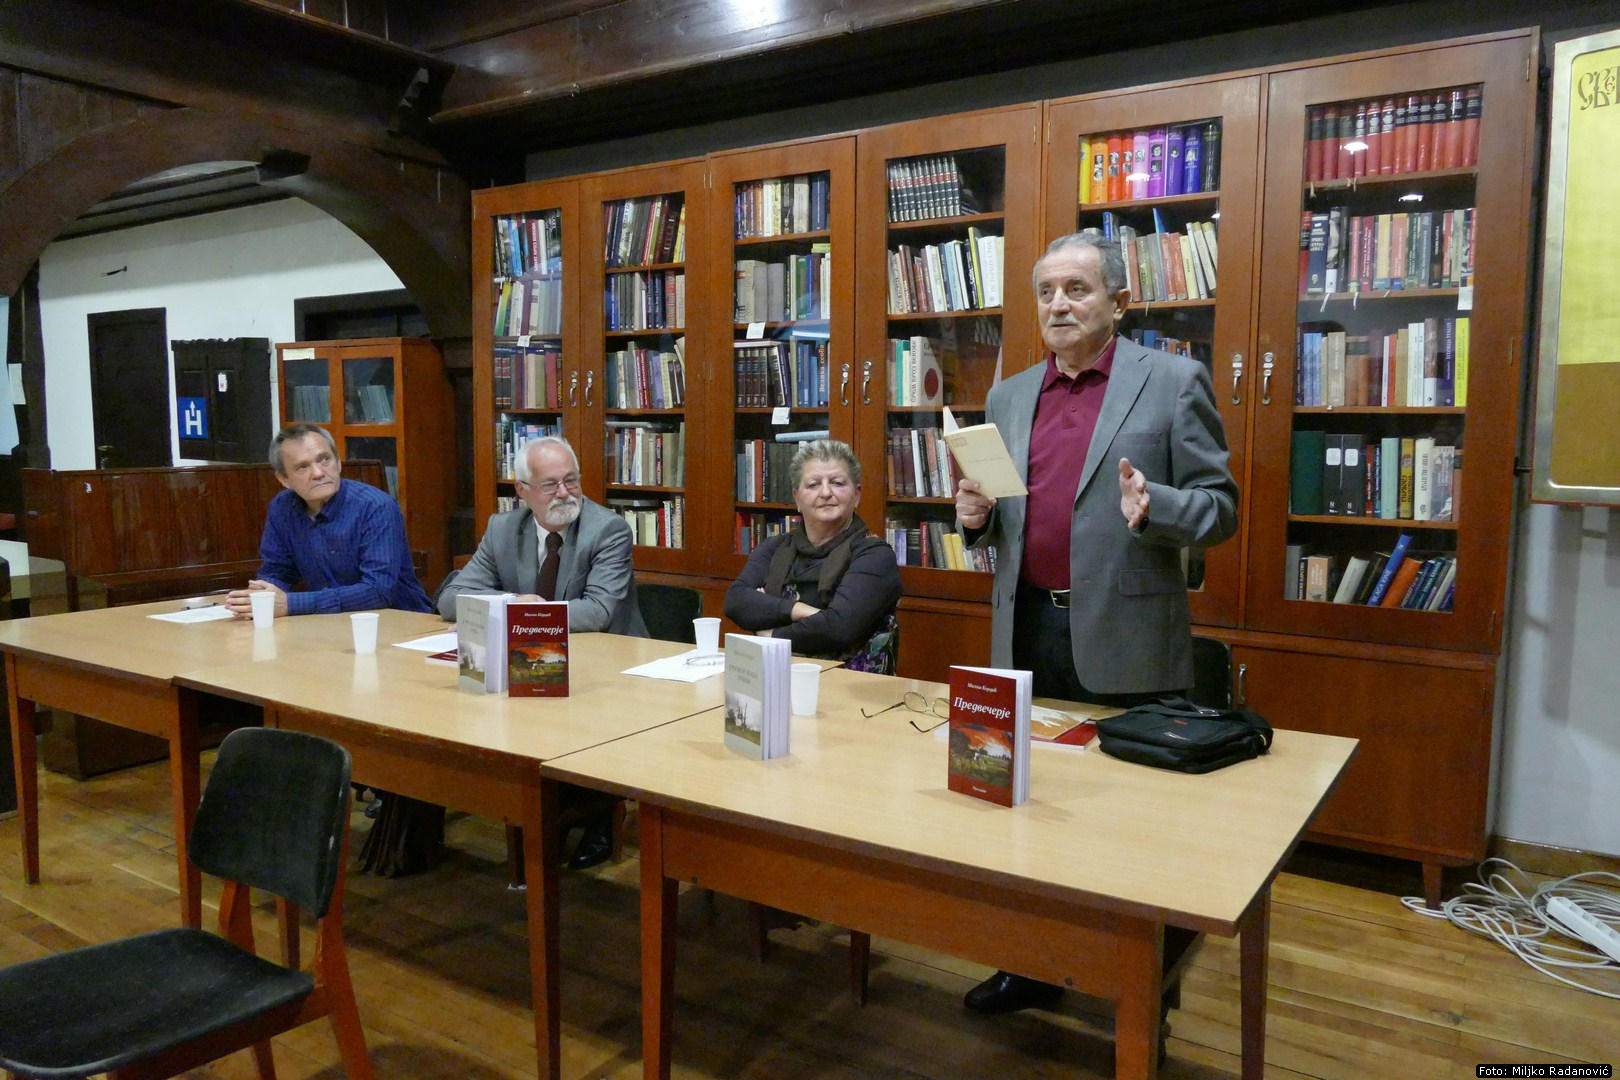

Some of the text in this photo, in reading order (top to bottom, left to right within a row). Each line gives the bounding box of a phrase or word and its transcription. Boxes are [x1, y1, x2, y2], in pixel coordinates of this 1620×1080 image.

[185, 410, 202, 435] H
[512, 624, 564, 636] Предвечерје
[953, 696, 1012, 720] Предвечерје
